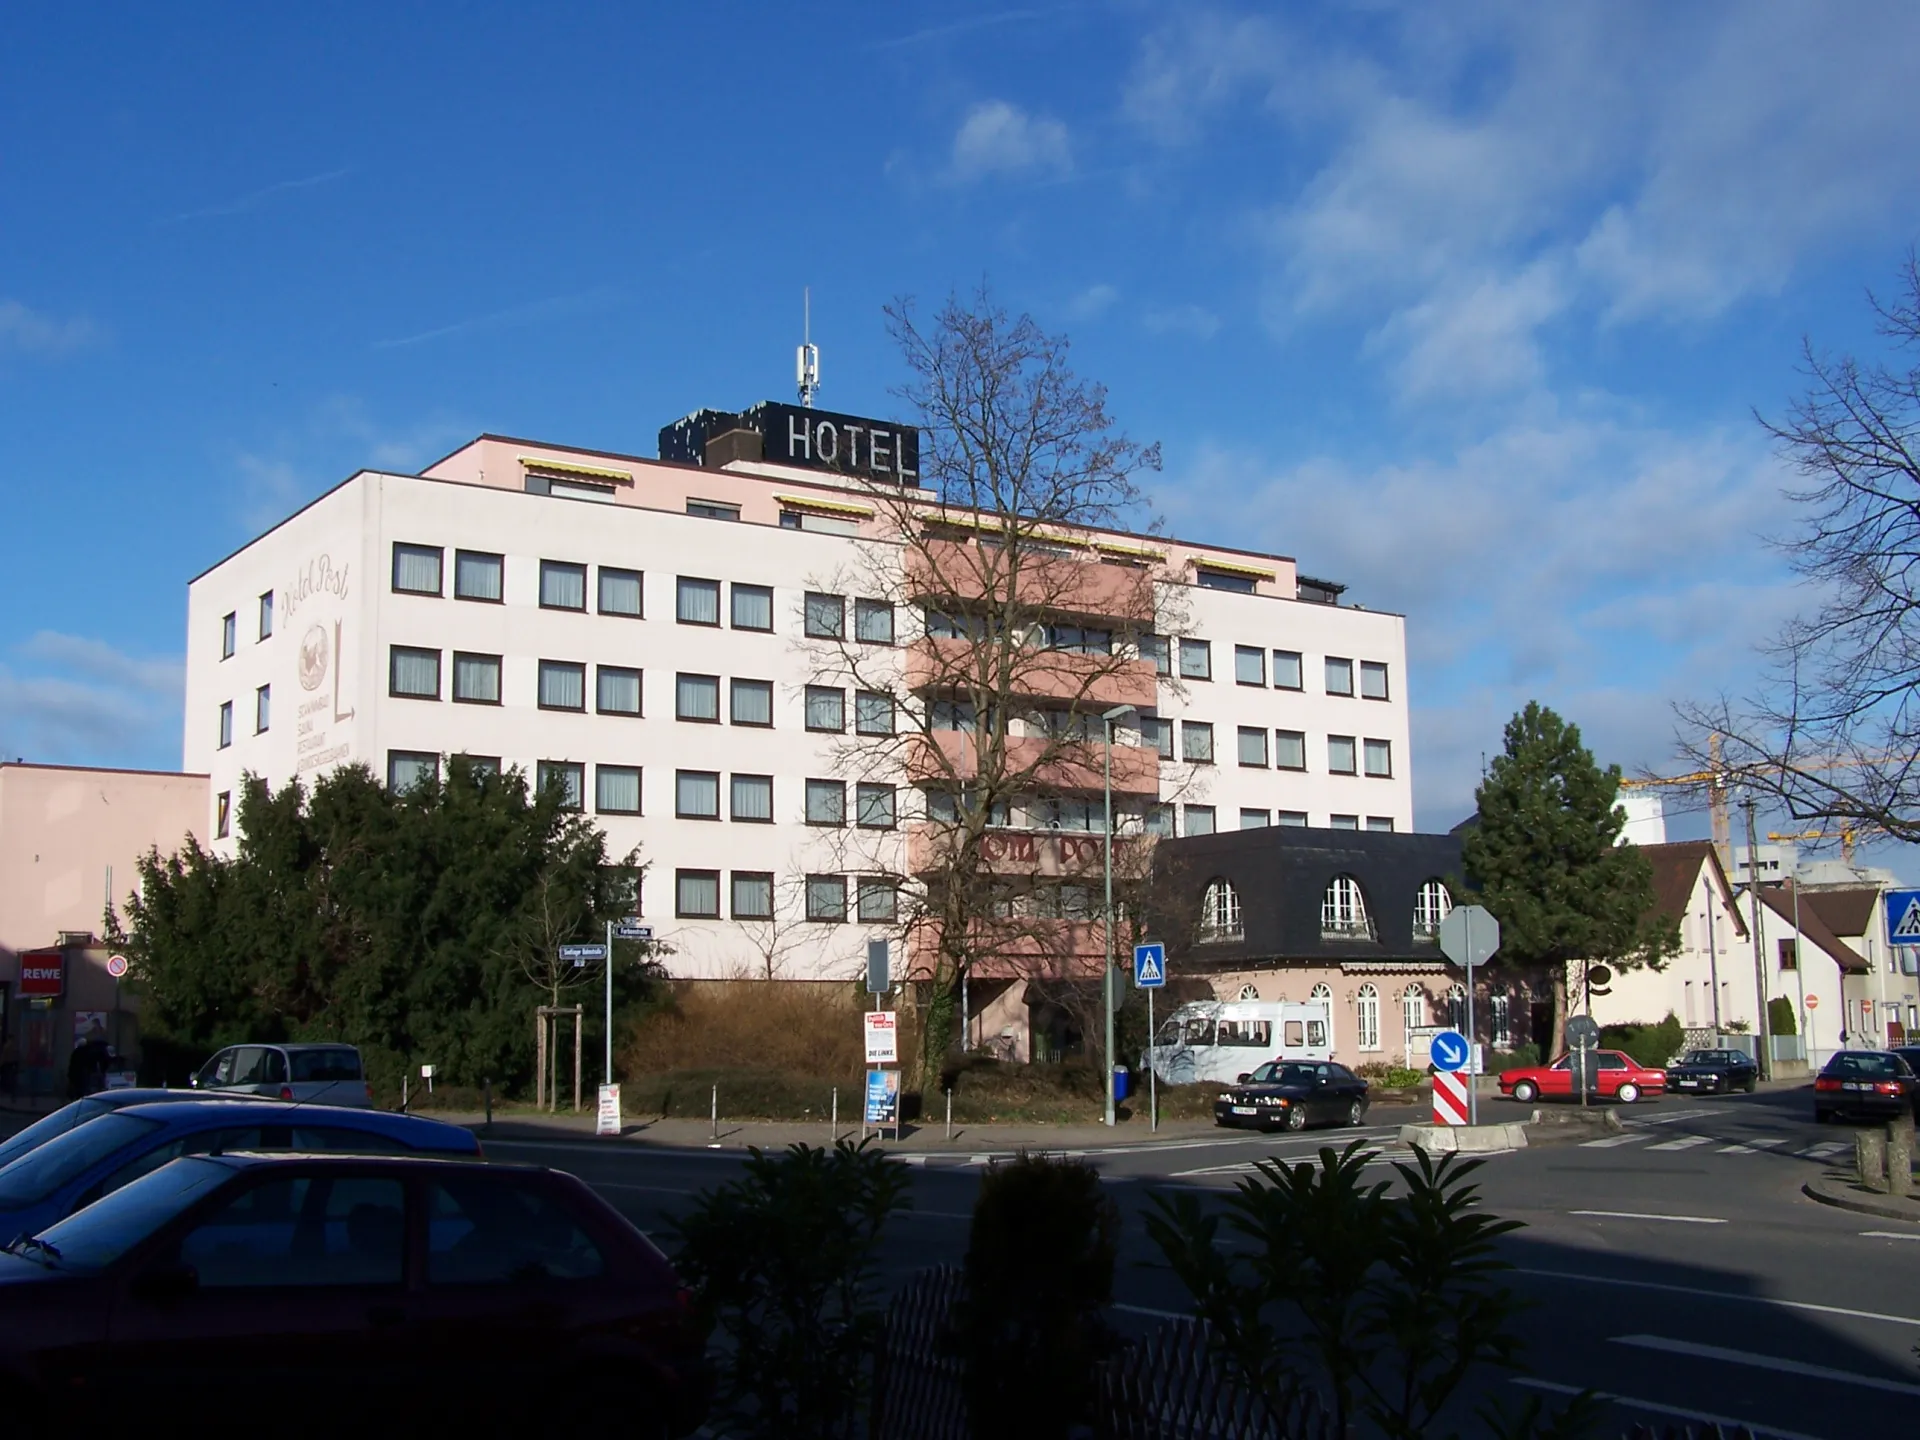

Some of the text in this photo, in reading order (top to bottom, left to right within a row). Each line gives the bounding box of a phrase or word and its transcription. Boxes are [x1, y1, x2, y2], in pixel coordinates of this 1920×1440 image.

[788, 414, 917, 478] HOTEL
[316, 553, 349, 601] Post
[23, 968, 61, 979] REWE
